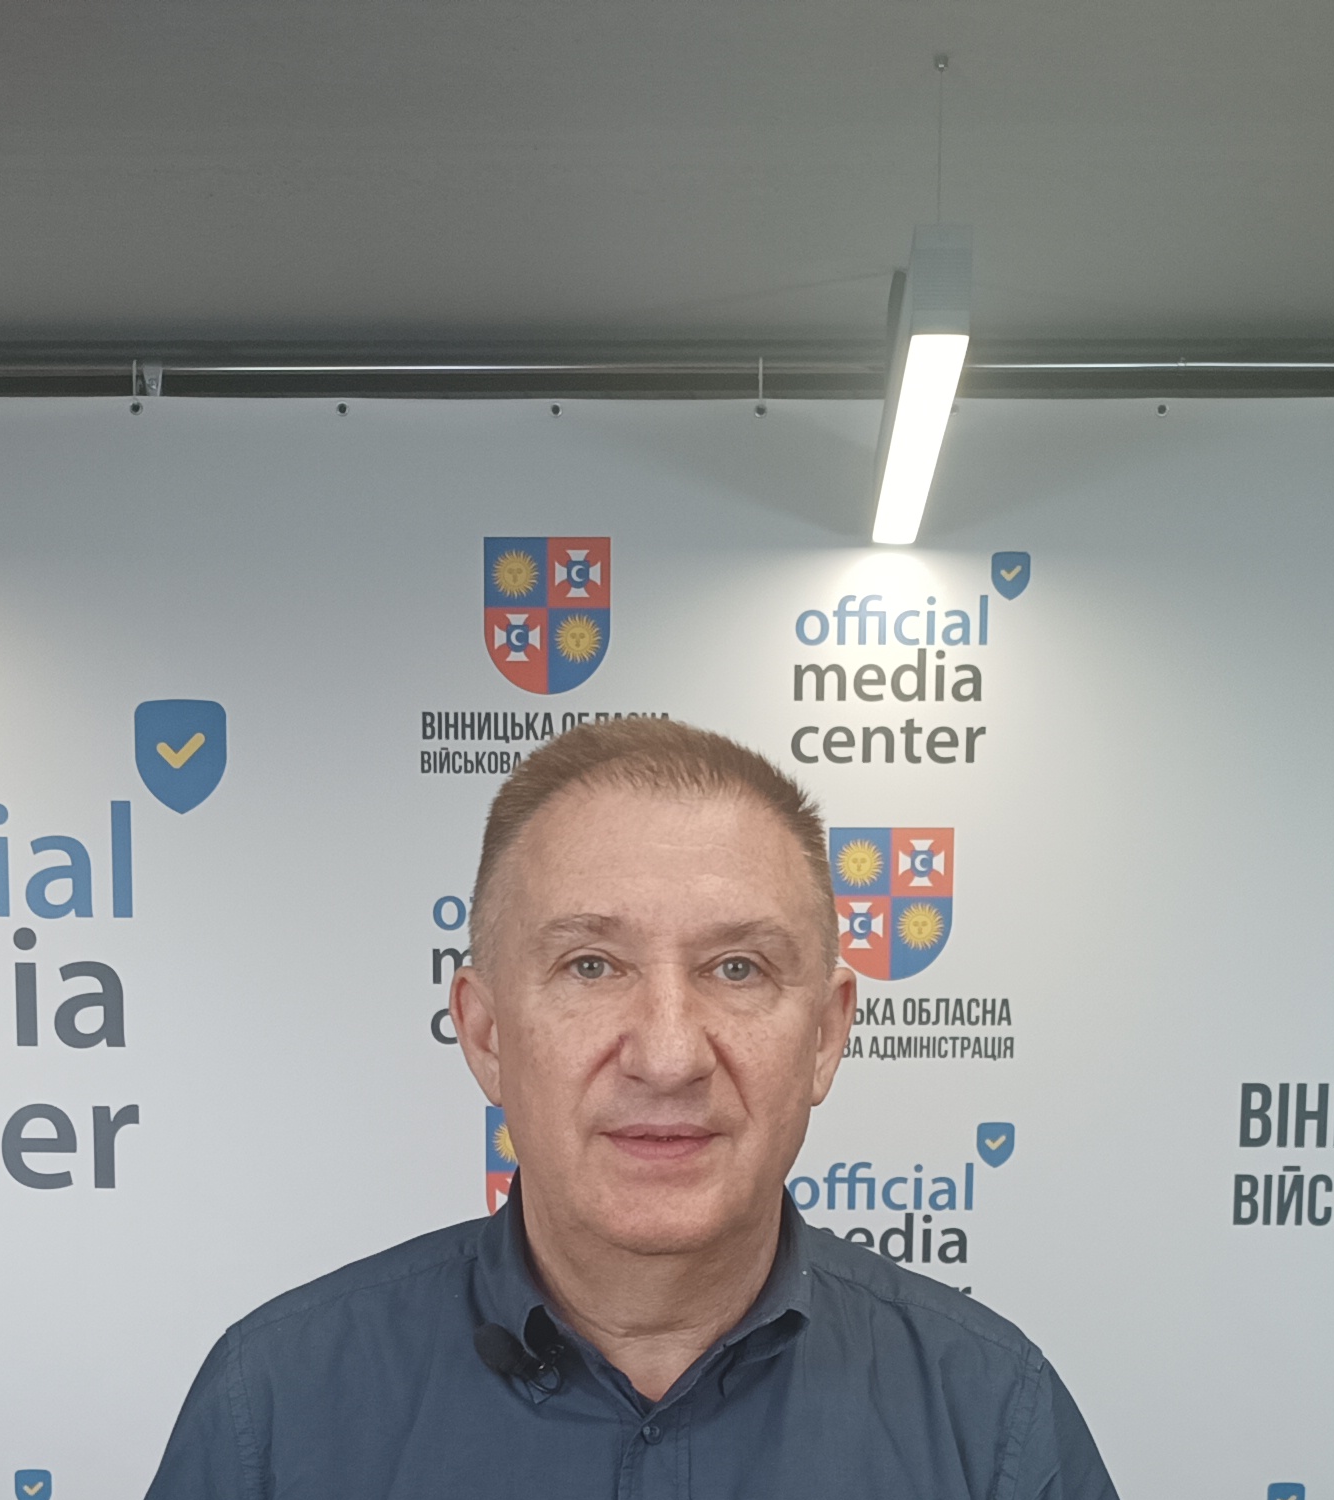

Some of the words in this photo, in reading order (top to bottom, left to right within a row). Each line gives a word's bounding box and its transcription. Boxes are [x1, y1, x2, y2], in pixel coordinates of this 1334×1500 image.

[796, 595, 988, 646] official
[794, 648, 982, 702] media
[422, 712, 552, 743] ВІННИЦЬКА
[791, 718, 986, 764] center
[903, 998, 1011, 1026] ОБЛАСНА
[869, 1036, 1014, 1061] АДМІНІСТРАЦІЯ
[787, 1161, 974, 1211] official
[818, 1212, 968, 1264] edia
